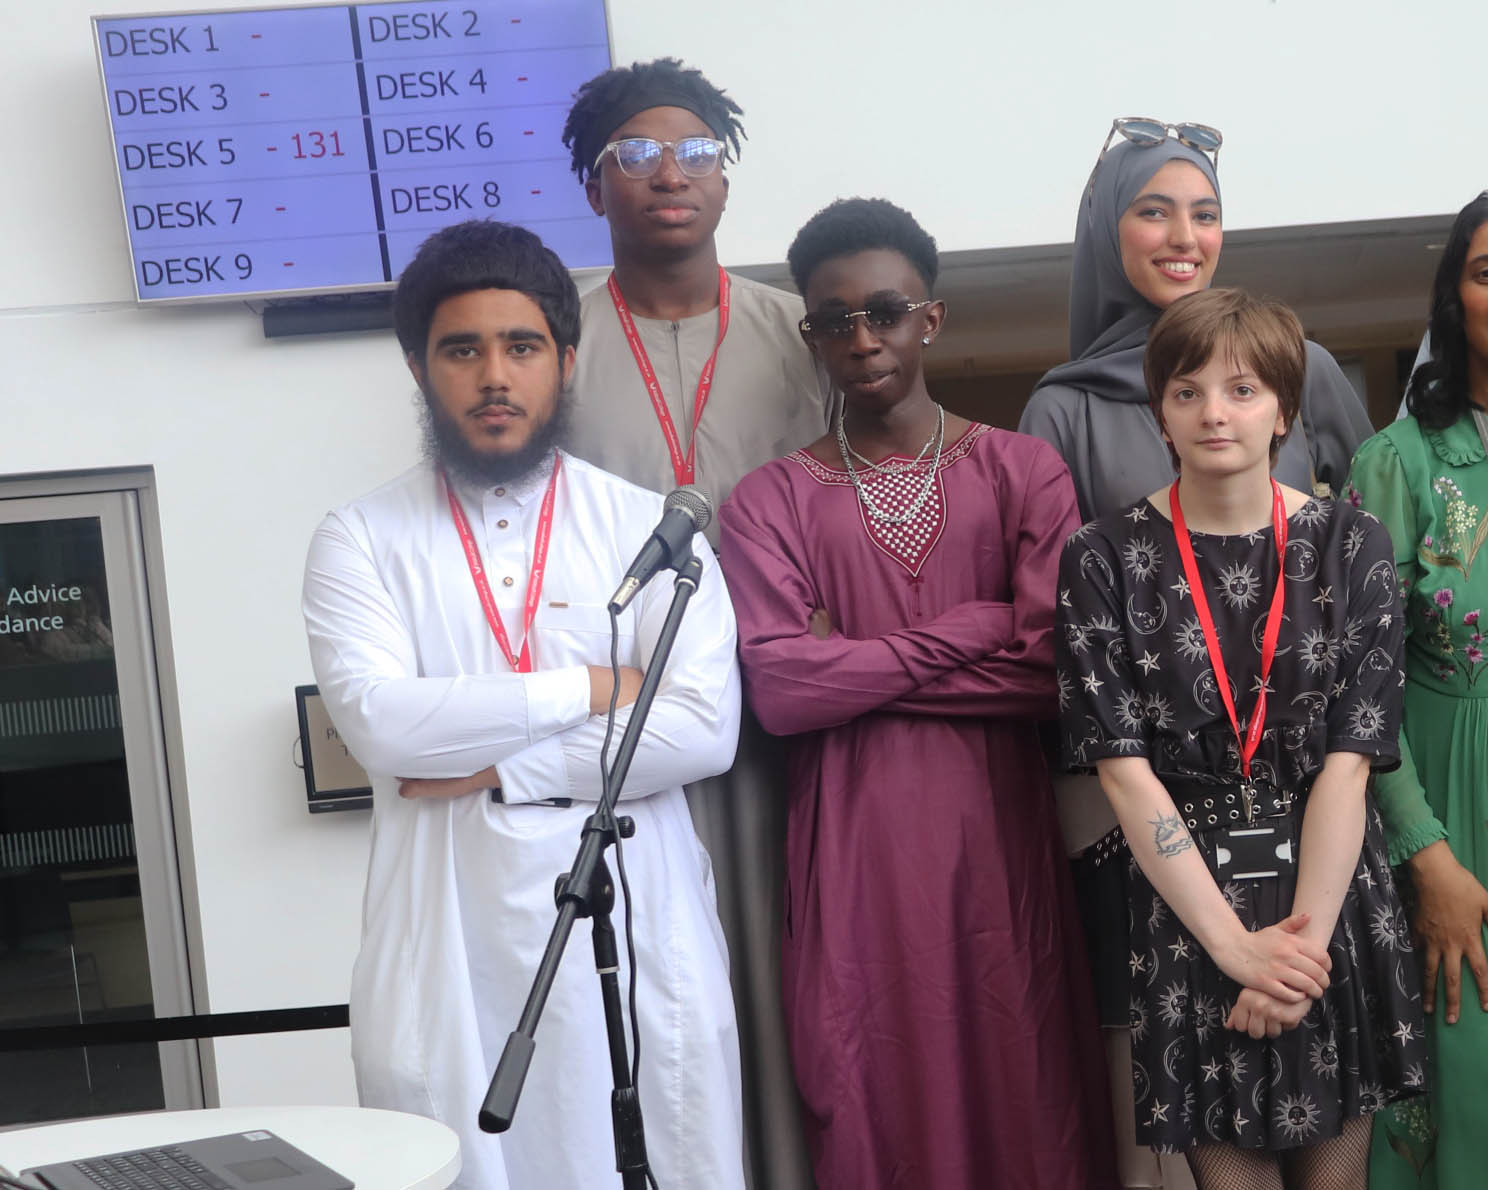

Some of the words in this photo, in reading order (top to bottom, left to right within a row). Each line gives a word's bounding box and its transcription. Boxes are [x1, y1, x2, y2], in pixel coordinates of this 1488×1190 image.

[104, 27, 190, 57] DESK
[203, 26, 220, 52] 1
[368, 13, 452, 43] DESK
[462, 10, 481, 37] 2
[113, 86, 199, 117] DESK
[209, 83, 228, 111] 3
[375, 70, 459, 101] DESK
[468, 68, 487, 94] 4
[122, 141, 208, 172] DESK
[218, 138, 236, 165] 5
[291, 130, 345, 159] 131
[382, 124, 465, 155] DESK
[475, 121, 494, 149] 6
[131, 198, 217, 231] DESK
[225, 198, 243, 225] 7
[390, 183, 473, 215] DESK
[482, 181, 501, 209] 8
[140, 255, 225, 287] DESK
[234, 253, 253, 281] 9
[7, 583, 82, 606] Advice
[0, 614, 64, 634] dance
